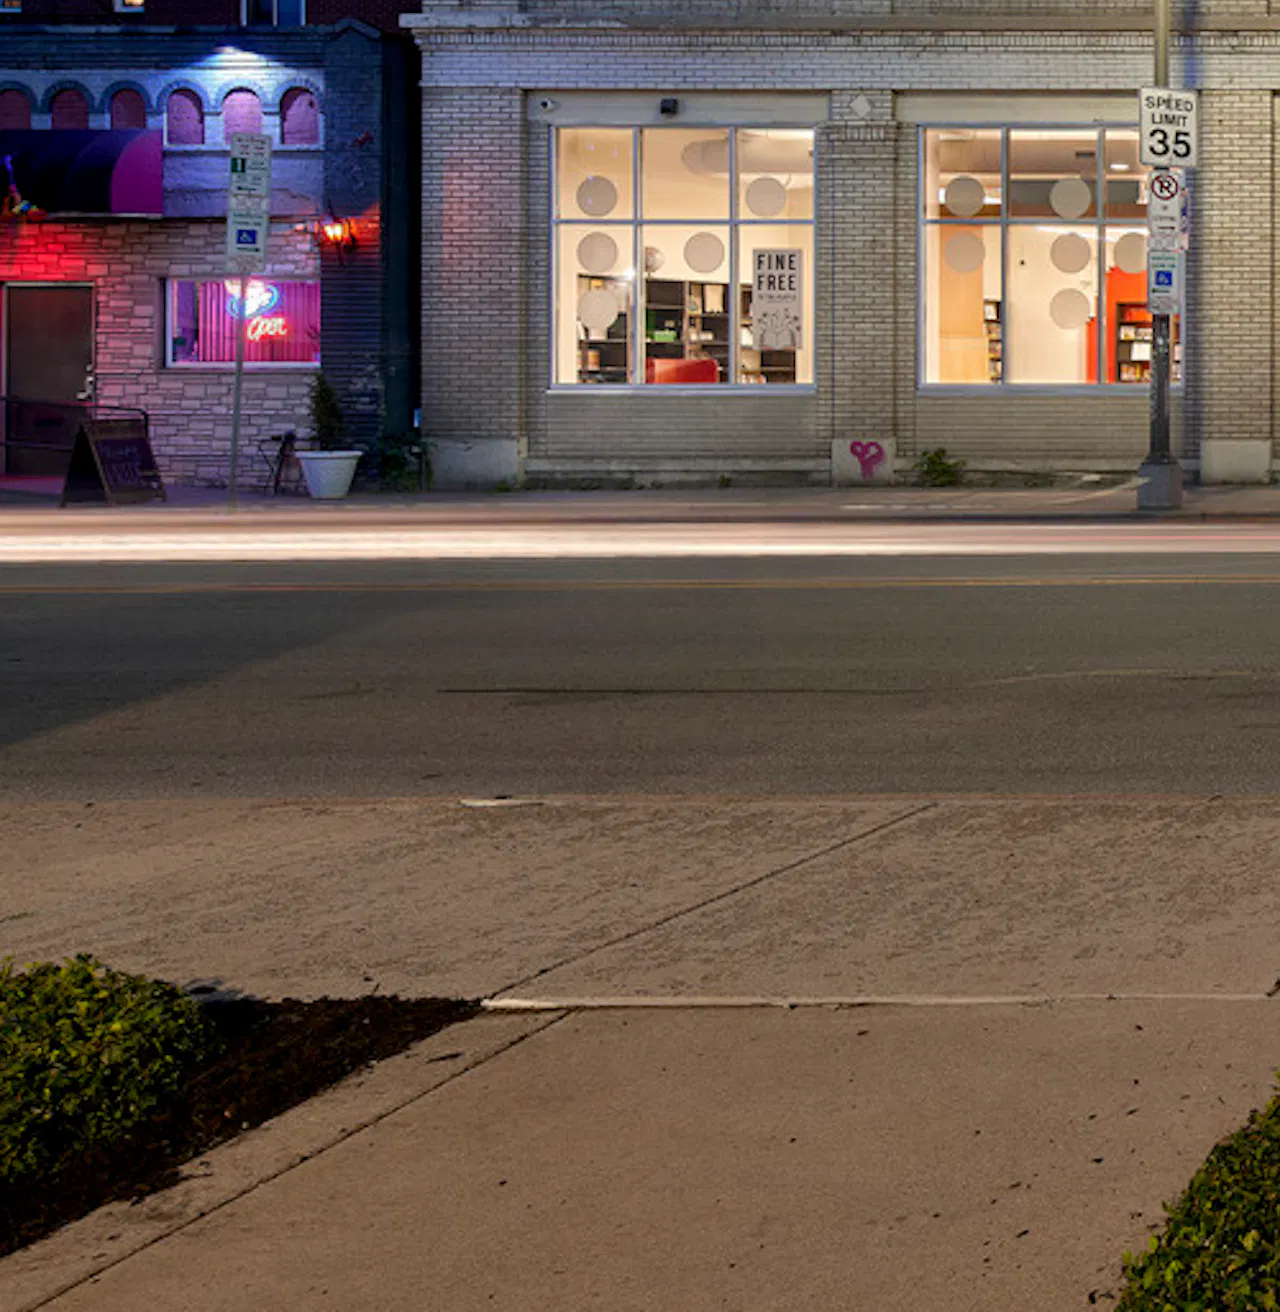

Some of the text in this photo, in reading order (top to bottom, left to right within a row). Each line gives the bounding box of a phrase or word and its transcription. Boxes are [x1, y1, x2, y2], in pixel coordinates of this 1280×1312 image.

[1146, 96, 1193, 112] SPEED
[1152, 113, 1188, 127] LIMIT
[1150, 129, 1191, 158] 35
[757, 254, 797, 270] FINE
[757, 274, 797, 291] FREE
